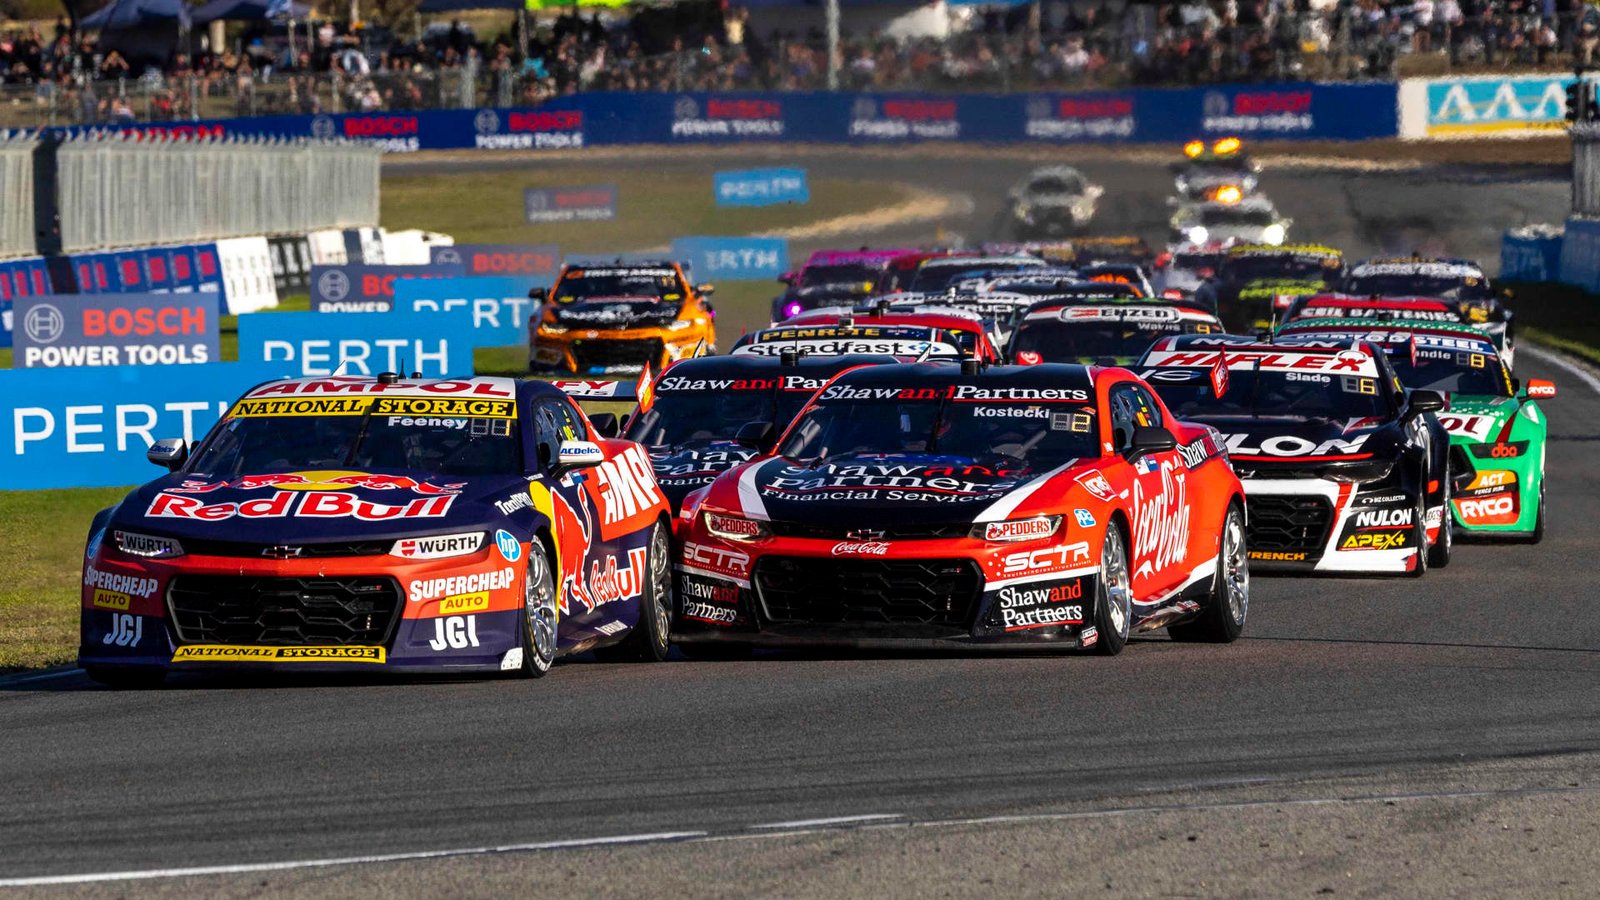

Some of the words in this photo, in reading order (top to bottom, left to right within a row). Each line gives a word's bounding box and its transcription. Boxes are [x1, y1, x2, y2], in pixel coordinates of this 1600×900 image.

[345, 117, 418, 137] BOSCH
[509, 110, 583, 131] BOSCH
[475, 133, 532, 149] POWER
[535, 132, 583, 148] TOOLS
[472, 253, 552, 272] BOSCH
[705, 249, 779, 270] ERTH
[83, 307, 207, 337] BOSCH
[1101, 308, 1169, 318] ENZED
[748, 341, 904, 355] Steadfast
[1415, 335, 1484, 351] STEEL
[25, 346, 120, 367] POWER
[124, 344, 208, 366] TOOLS
[263, 339, 449, 377] PERTH
[1415, 349, 1451, 360] andle
[1470, 353, 1485, 368] 8
[1285, 372, 1332, 384] Slade
[1359, 378, 1376, 395] 6
[250, 381, 512, 398] AMPOL
[1528, 386, 1555, 396] RYCO
[236, 400, 364, 415] NATIONAL
[378, 399, 509, 417] STORAGE
[973, 405, 1050, 419] Kostecki
[14, 401, 230, 455] PERT
[387, 416, 469, 430] Feeney
[560, 446, 601, 456] ACDelco
[1219, 433, 1373, 457] LON
[766, 475, 1017, 493] Partners
[1479, 472, 1506, 487] ACT
[761, 489, 878, 502] Financial
[886, 490, 1004, 503] Services
[144, 490, 299, 522] Red
[294, 490, 459, 522] Bull
[1460, 496, 1514, 519] RYCO
[719, 517, 759, 536] PEDDERS
[1355, 508, 1413, 528] NULON
[1002, 519, 1050, 537] PEDDERS
[418, 535, 479, 554] WÜRTH
[500, 534, 516, 559] hp
[683, 540, 750, 572] SCTR
[1003, 541, 1091, 573] SCTR
[409, 566, 515, 602] SUPERCHEAP
[97, 593, 127, 606] AUTO
[445, 596, 484, 610] AUTO
[680, 595, 738, 623] Partners
[1001, 604, 1083, 629] Partners
[103, 612, 143, 648] JGI
[429, 614, 480, 651] JGI
[178, 647, 274, 657] NATIONAL
[283, 647, 376, 658] STORAGE
